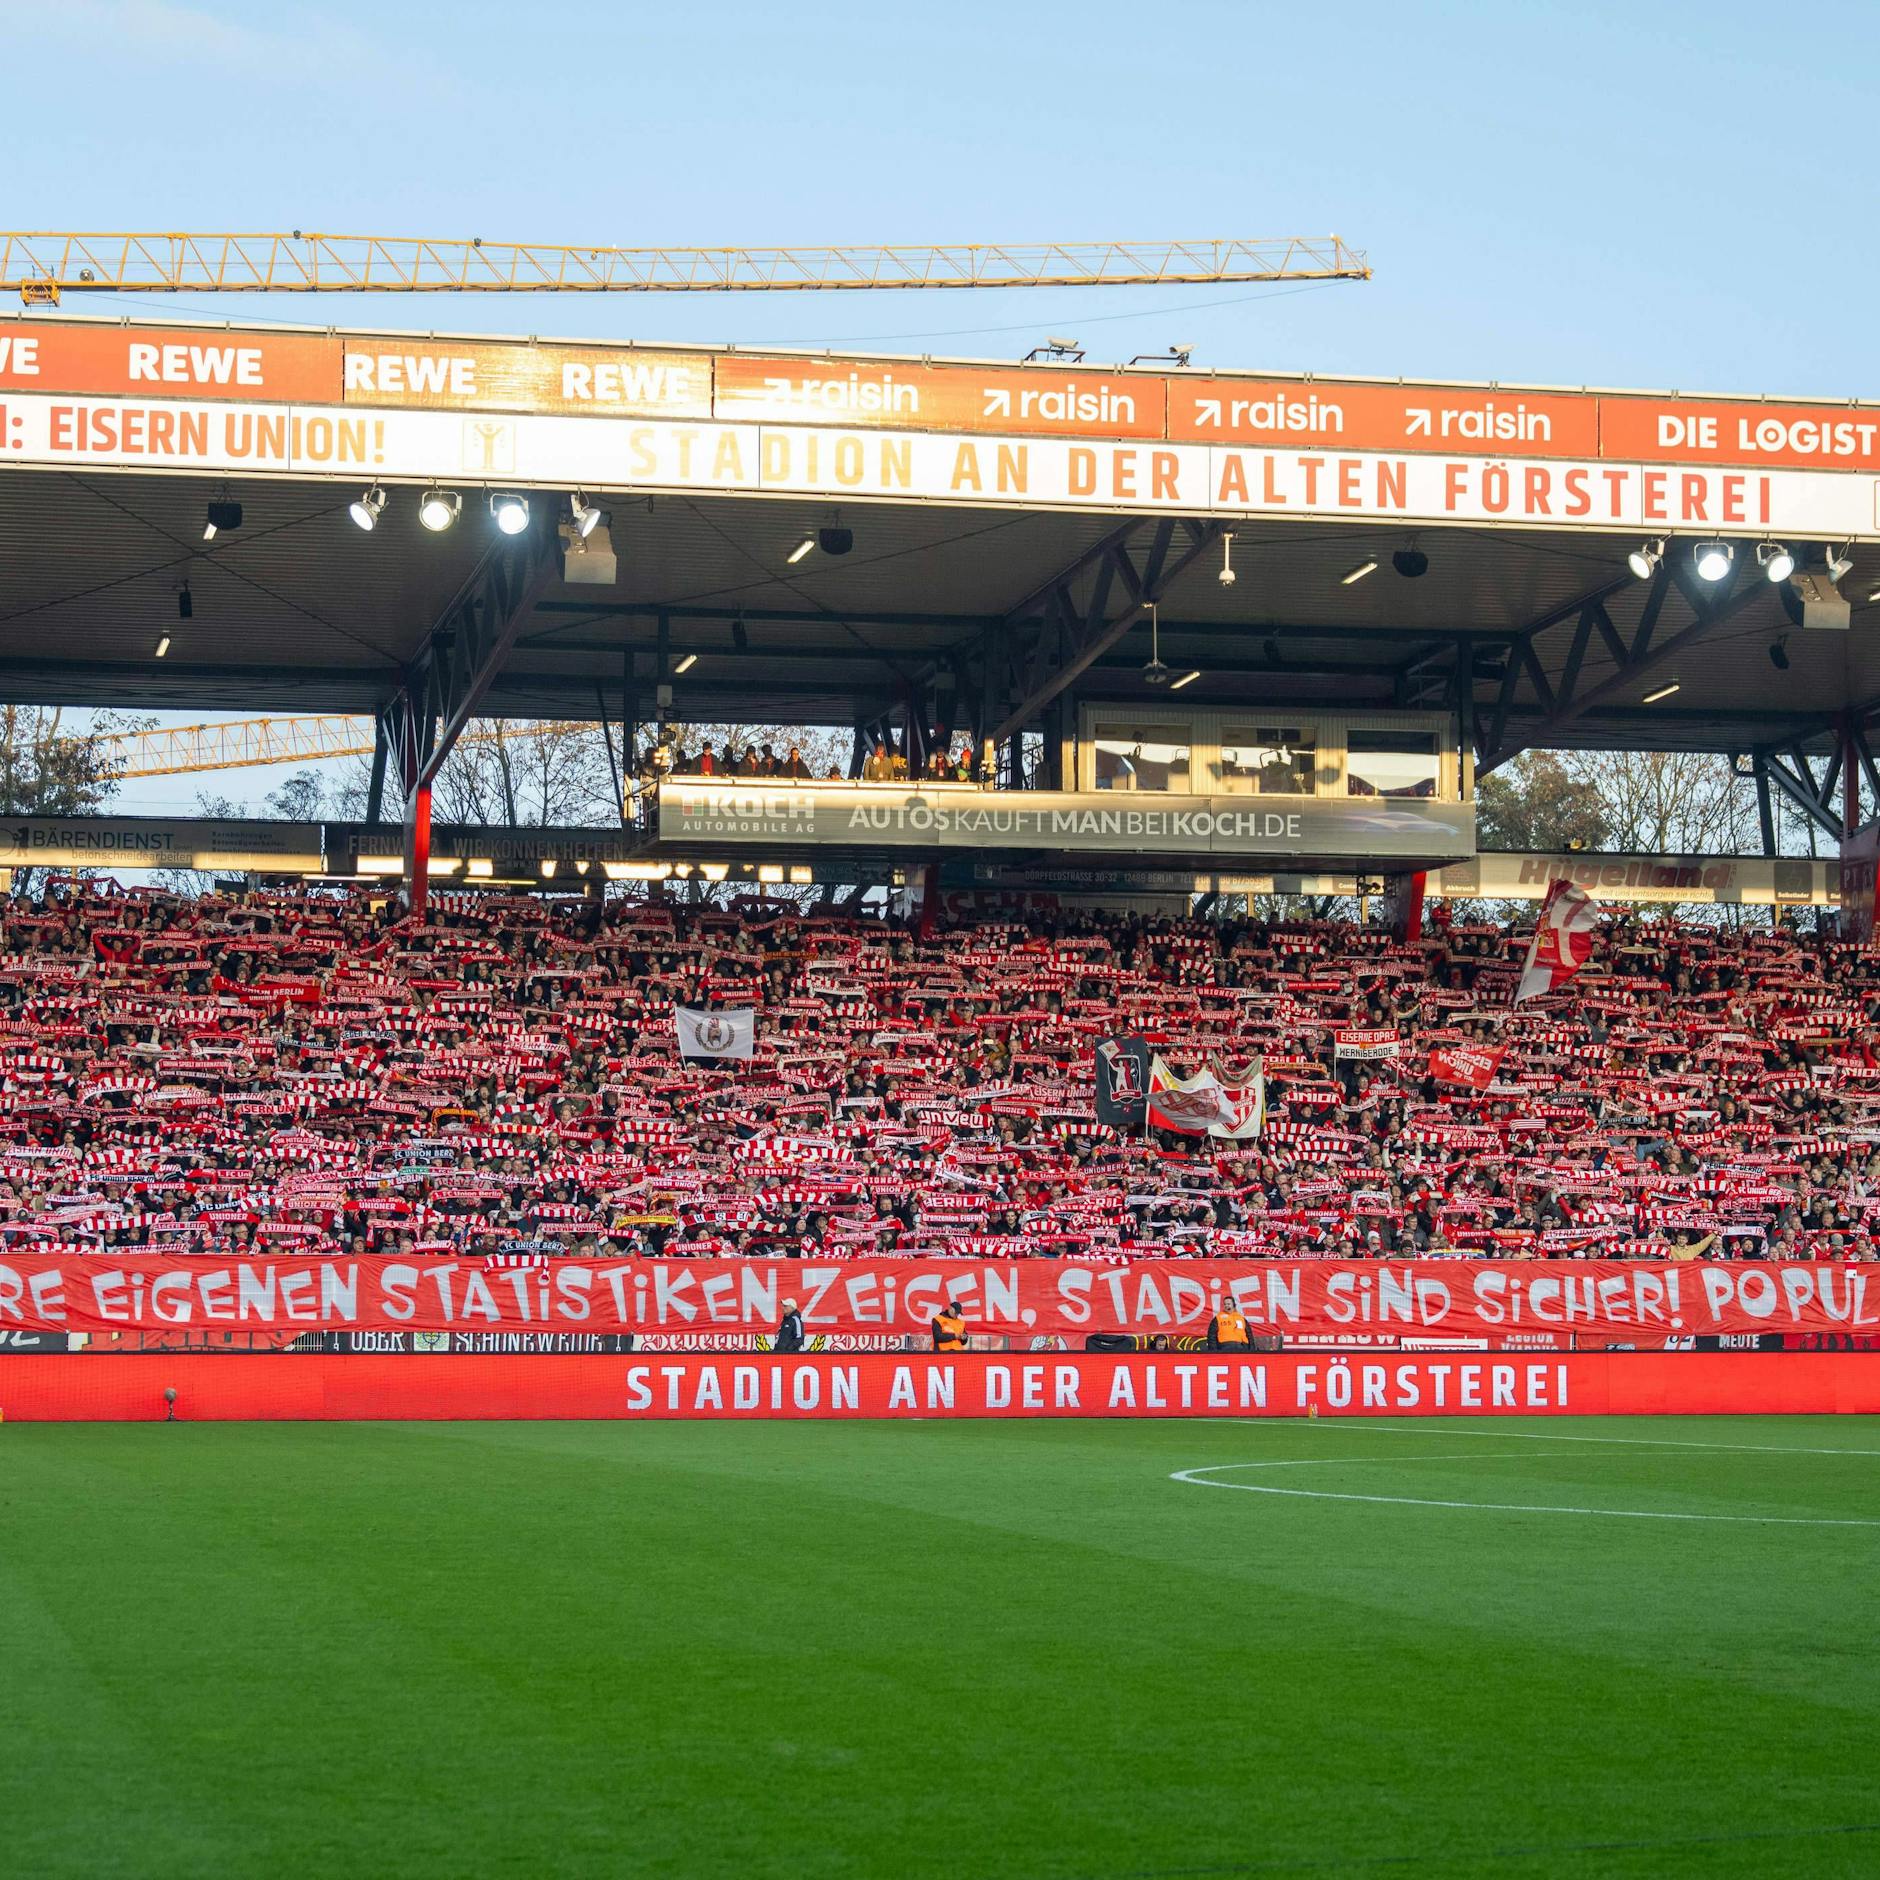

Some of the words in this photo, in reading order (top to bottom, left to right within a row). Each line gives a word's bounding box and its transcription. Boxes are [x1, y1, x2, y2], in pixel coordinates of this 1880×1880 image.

[129, 342, 264, 386] REWE
[345, 353, 477, 396] REWE
[562, 362, 691, 402] REWE
[799, 372, 919, 413] raisin
[1020, 384, 1136, 424] raisin
[1232, 393, 1344, 433] raisin
[1441, 403, 1551, 441] raisin
[50, 406, 208, 456] EISERN
[225, 413, 385, 464] UNION!
[1658, 414, 1718, 449] DIE
[1738, 418, 1878, 456] LOGIST
[629, 427, 912, 488] STADION
[950, 442, 1029, 494] AN
[1068, 447, 1181, 500] DER
[1218, 454, 1407, 509] ALTEN
[1445, 460, 1770, 524] FÖRSTEREI
[706, 795, 815, 819] KOCH
[683, 822, 788, 834] AUTOMOBILE
[796, 823, 815, 834] AG
[33, 828, 175, 851] BÄRENDIENST
[273, 986, 305, 997] BERLIN
[1592, 1000, 1613, 1010] Union
[1374, 1031, 1396, 1042] OPAS
[182, 1098, 218, 1106] UNIONER
[992, 1105, 1027, 1115] UNIONER
[1543, 1108, 1585, 1117] UNIONER
[560, 1130, 593, 1140] UNIONER
[407, 1148, 433, 1157] UNION
[610, 1167, 647, 1178] UNIONER
[1085, 1166, 1106, 1175] UNION
[398, 1175, 425, 1186] BERLIN
[457, 1190, 477, 1198] Union
[199, 1203, 214, 1212] FC
[359, 1202, 397, 1210] UNIONER
[210, 1212, 248, 1221] UNIONER
[517, 1241, 541, 1250] UNION
[675, 1243, 714, 1253] UNIONER
[91, 1263, 359, 1323] EiGENEN
[1473, 1267, 1684, 1329] SiCHER!
[626, 1365, 860, 1410] STADION
[888, 1365, 954, 1409] AN
[985, 1365, 1081, 1408] DER
[1108, 1365, 1267, 1408] ALTEN
[1296, 1357, 1568, 1408] FÖRSTEREI
